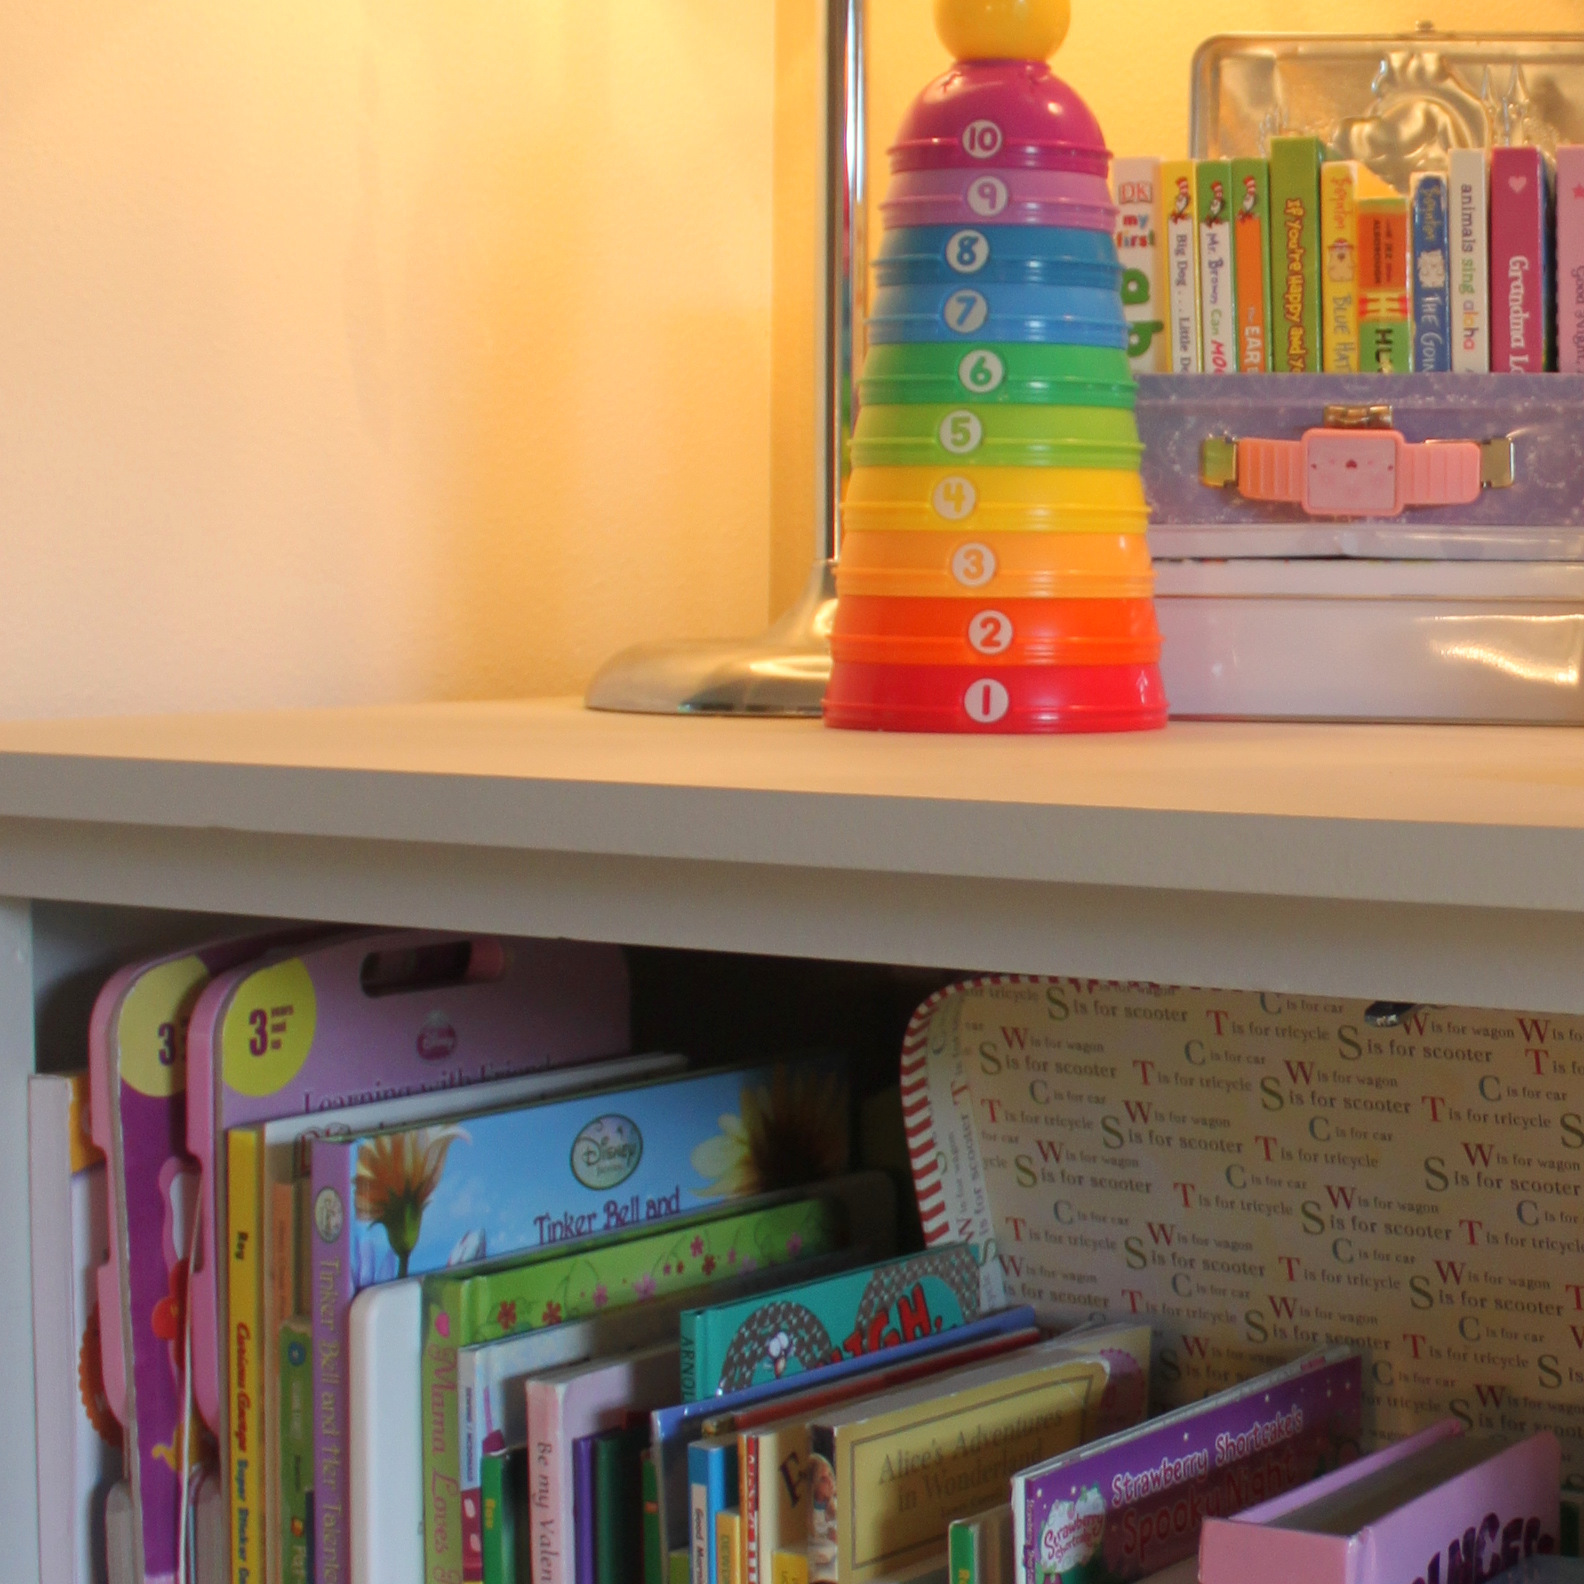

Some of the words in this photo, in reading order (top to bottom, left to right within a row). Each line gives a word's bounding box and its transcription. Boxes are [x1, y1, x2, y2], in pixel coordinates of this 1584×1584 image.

[968, 126, 997, 151] 10
[977, 183, 997, 210] 9
[1120, 182, 1152, 204] DK
[1117, 230, 1155, 249] first
[1460, 184, 1475, 254] animals
[956, 235, 980, 265] 8
[1206, 233, 1219, 254] Mr.
[1207, 257, 1224, 304] Brown
[1459, 255, 1475, 296] sing
[956, 295, 977, 326] 7
[1284, 274, 1305, 323] Happy
[1333, 295, 1352, 335] BLUE
[1421, 294, 1441, 324] THE
[1507, 255, 1529, 348] Grandma
[1178, 317, 1191, 351] Little
[1210, 309, 1223, 335] Can
[1286, 327, 1306, 354] and
[1462, 300, 1480, 351] aloha
[969, 356, 991, 385] 6
[950, 416, 971, 447] 5
[942, 483, 965, 513] 4
[962, 548, 984, 580] 3
[979, 616, 1001, 647] 2
[158, 1023, 175, 1065] 3
[249, 1009, 267, 1056] 3
[534, 1206, 597, 1245] Tinker
[603, 1194, 640, 1230] Bell
[647, 1185, 682, 1220] and
[319, 1259, 341, 1334] Tinker
[320, 1339, 341, 1388] Bell
[321, 1390, 341, 1438] and
[426, 1345, 458, 1456] Mama
[536, 1441, 552, 1468] Be
[879, 1439, 943, 1486] Alice's
[954, 1408, 1062, 1453] Adventures
[1112, 1448, 1209, 1507] Strawberry
[1215, 1404, 1304, 1465] Shortcake's
[236, 1460, 249, 1504] Super
[532, 1479, 550, 1508] my
[431, 1471, 460, 1555] Loves
[1123, 1488, 1219, 1561] Spooky
[1223, 1450, 1300, 1513] Night
[236, 1509, 249, 1564] Sticker
[1045, 1511, 1104, 1560] Strawberry
